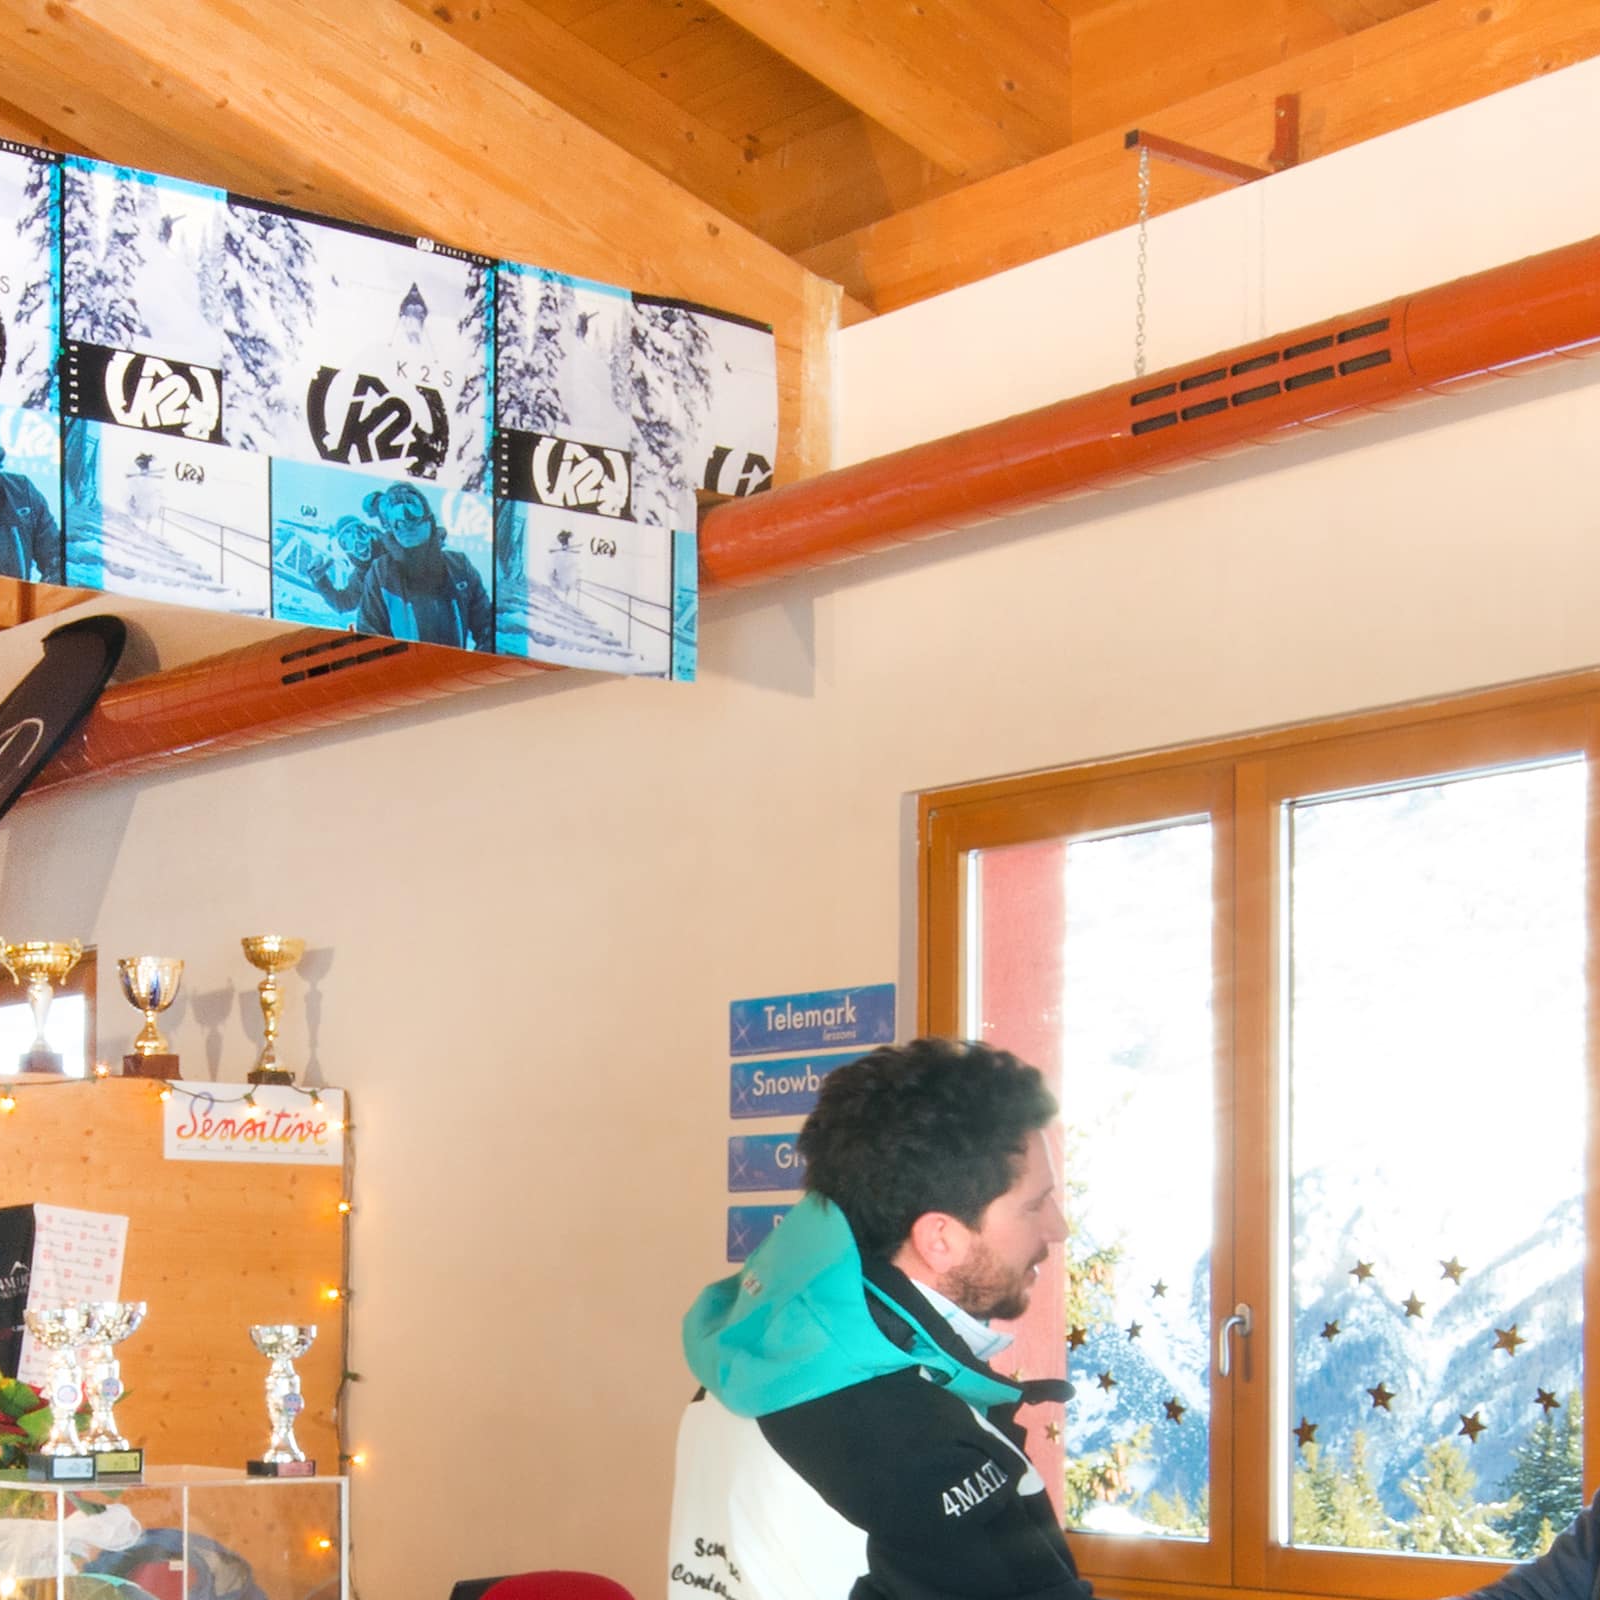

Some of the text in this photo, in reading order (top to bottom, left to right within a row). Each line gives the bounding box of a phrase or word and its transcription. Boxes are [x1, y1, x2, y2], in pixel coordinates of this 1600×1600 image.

[763, 996, 857, 1031] Telemark
[752, 1065, 826, 1096] Snowb
[176, 1091, 329, 1146] Sensitive
